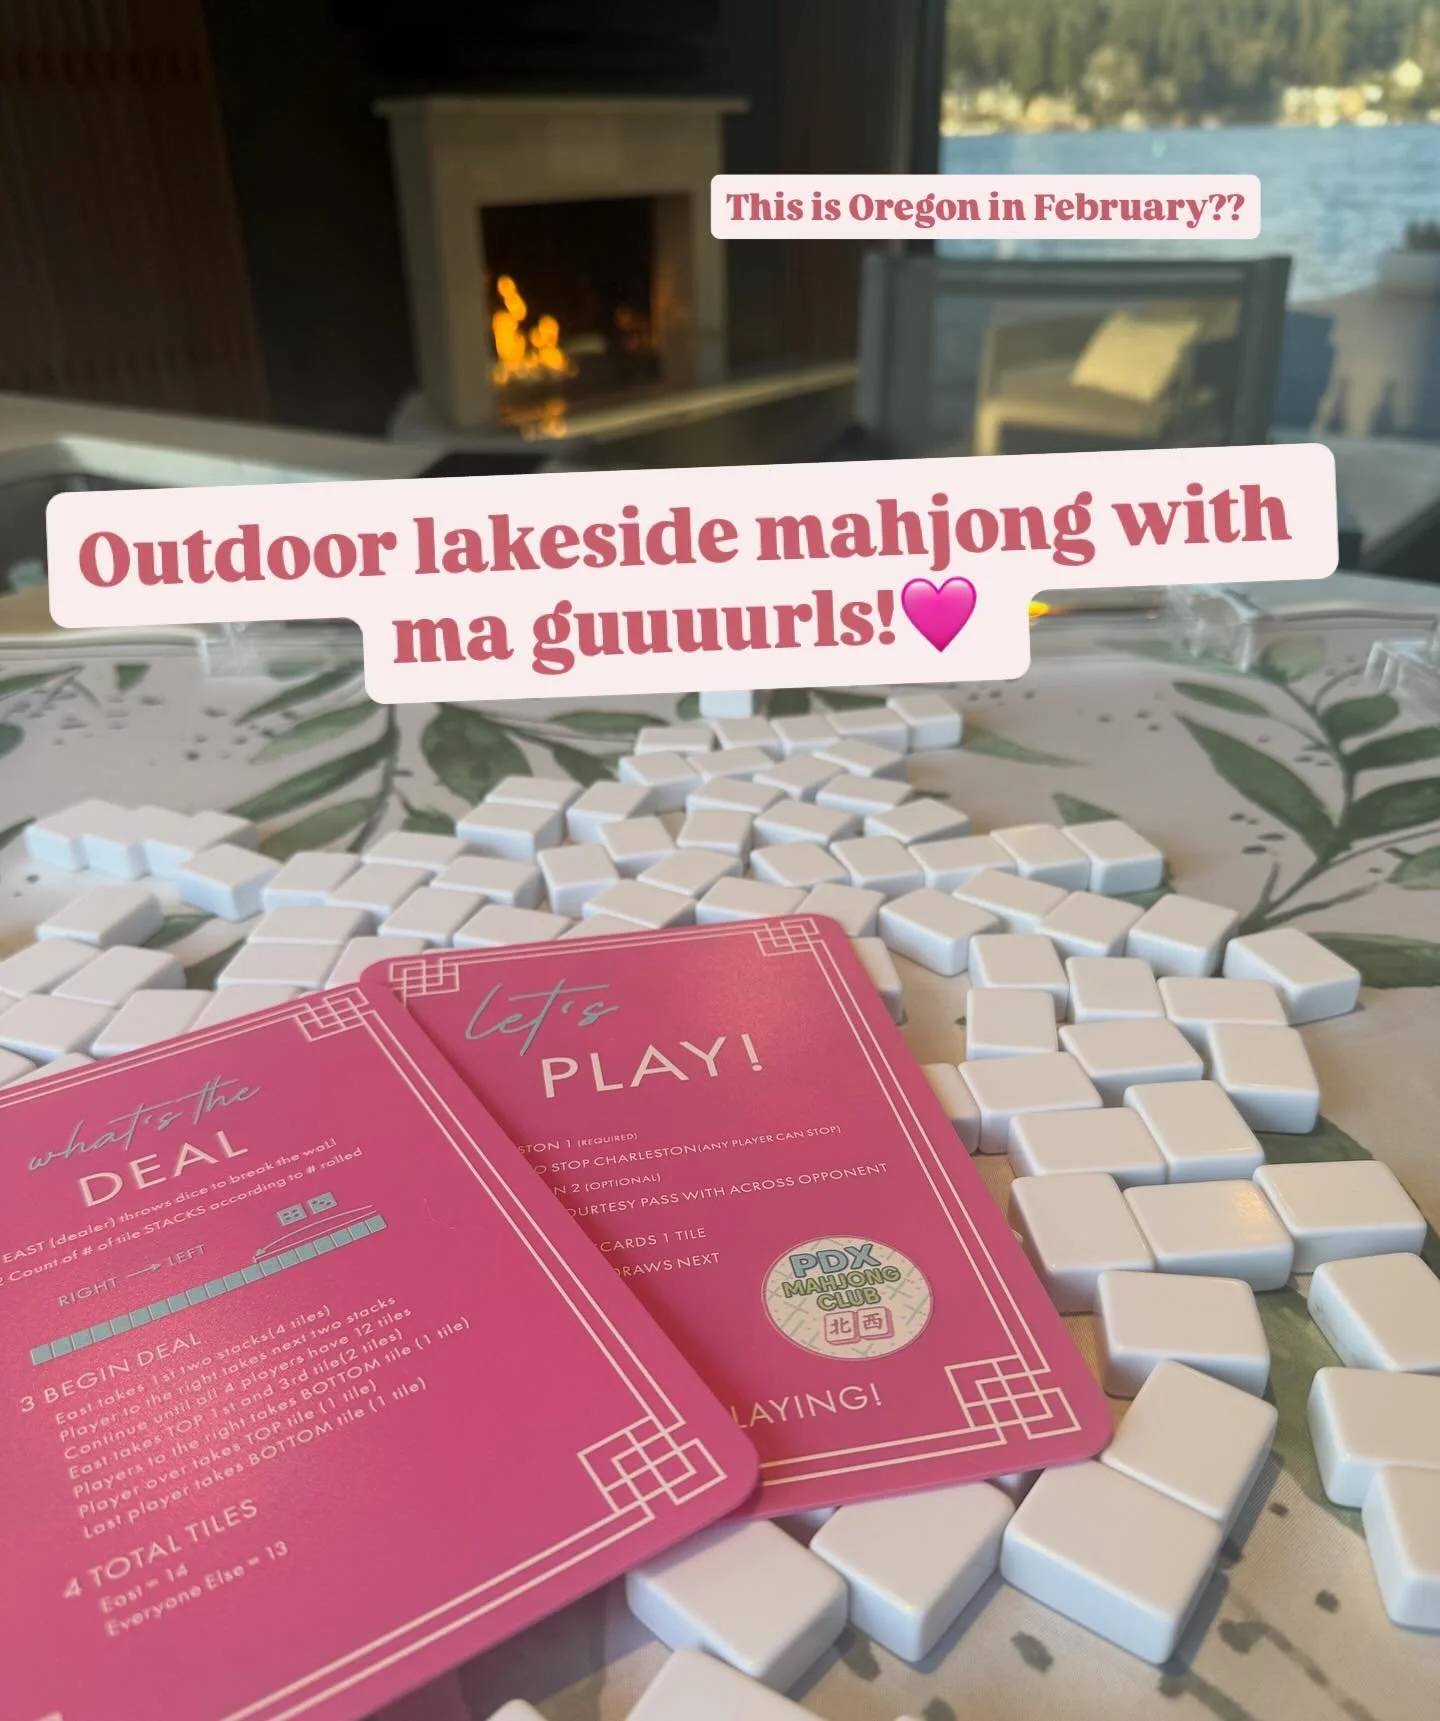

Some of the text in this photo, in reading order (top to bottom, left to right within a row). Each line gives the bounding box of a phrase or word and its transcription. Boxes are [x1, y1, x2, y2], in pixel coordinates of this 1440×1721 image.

[465, 978, 620, 1057] let's
[541, 1033, 763, 1099] PLAY!
[28, 1074, 261, 1171] what's the
[551, 1159, 590, 1173] STOP
[732, 1135, 774, 1148] PLAYER
[776, 1130, 804, 1141] CAN
[806, 1125, 841, 1137] STOP)
[566, 1139, 572, 1149] 1
[577, 1132, 638, 1148] (REQUIRED)
[3, 1137, 337, 1263] EAST (dealer) throws dice to break the wall
[79, 1130, 249, 1208] DEAL
[572, 1184, 580, 1193] 2
[585, 1173, 661, 1193] (OPTIONAL)
[641, 1193, 679, 1207] PASS
[682, 1186, 725, 1201] WITH
[730, 1176, 795, 1195] ACROSS
[798, 1162, 888, 1185] OPPONENT
[9, 1259, 59, 1281] Count
[62, 1250, 78, 1263] of
[82, 1246, 93, 1256] #
[98, 1237, 117, 1251] of
[117, 1230, 141, 1245] tile
[144, 1205, 206, 1234] STACKS
[210, 1178, 287, 1211] according
[289, 1171, 303, 1181] to
[306, 1165, 316, 1174] #
[321, 1147, 363, 1169] rolled
[597, 1227, 707, 1252] CARDS 1 TILE
[58, 1244, 205, 1307] RIGHT LEFT
[677, 1252, 720, 1269] NEXT
[782, 1266, 901, 1298] MAHJONG
[789, 1243, 881, 1278] PDX
[816, 1287, 881, 1311] CLUB
[830, 1313, 883, 1335] 北 西
[20, 1332, 201, 1413] 3 BEGIN DEAL
[55, 1403, 93, 1425] East
[98, 1384, 145, 1406] takes
[152, 1369, 177, 1386] 1st
[181, 1356, 213, 1375] two
[290, 1304, 330, 1329] tiles)
[60, 1297, 396, 1442] Player to the right takes next two stacks
[64, 1308, 412, 1460] Continue until all 4 players have 12 tiles
[69, 1457, 108, 1480] East
[112, 1434, 162, 1461] takes
[167, 1413, 203, 1438] TOP
[211, 1402, 235, 1419] 1st
[240, 1383, 274, 1406] and
[279, 1368, 309, 1390] 3rd
[362, 1328, 403, 1354] tiles)
[73, 1316, 470, 1499] Players to the right takes BOTTOM tile (1 tile)
[78, 1378, 377, 1519] Player over takes TOP tile (1 tile)
[83, 1514, 122, 1540] Last
[195, 1463, 244, 1490] takes
[248, 1421, 333, 1466] BOTTOM
[337, 1408, 365, 1426] tile
[369, 1395, 386, 1413] (1
[392, 1376, 427, 1400] tile)
[63, 1498, 257, 1599] 4 TOTAL TILES
[100, 1585, 143, 1614] East
[165, 1562, 189, 1583] 14
[105, 1584, 202, 1637] Everyone
[204, 1565, 245, 1590] Else
[265, 1540, 288, 1560] 13
